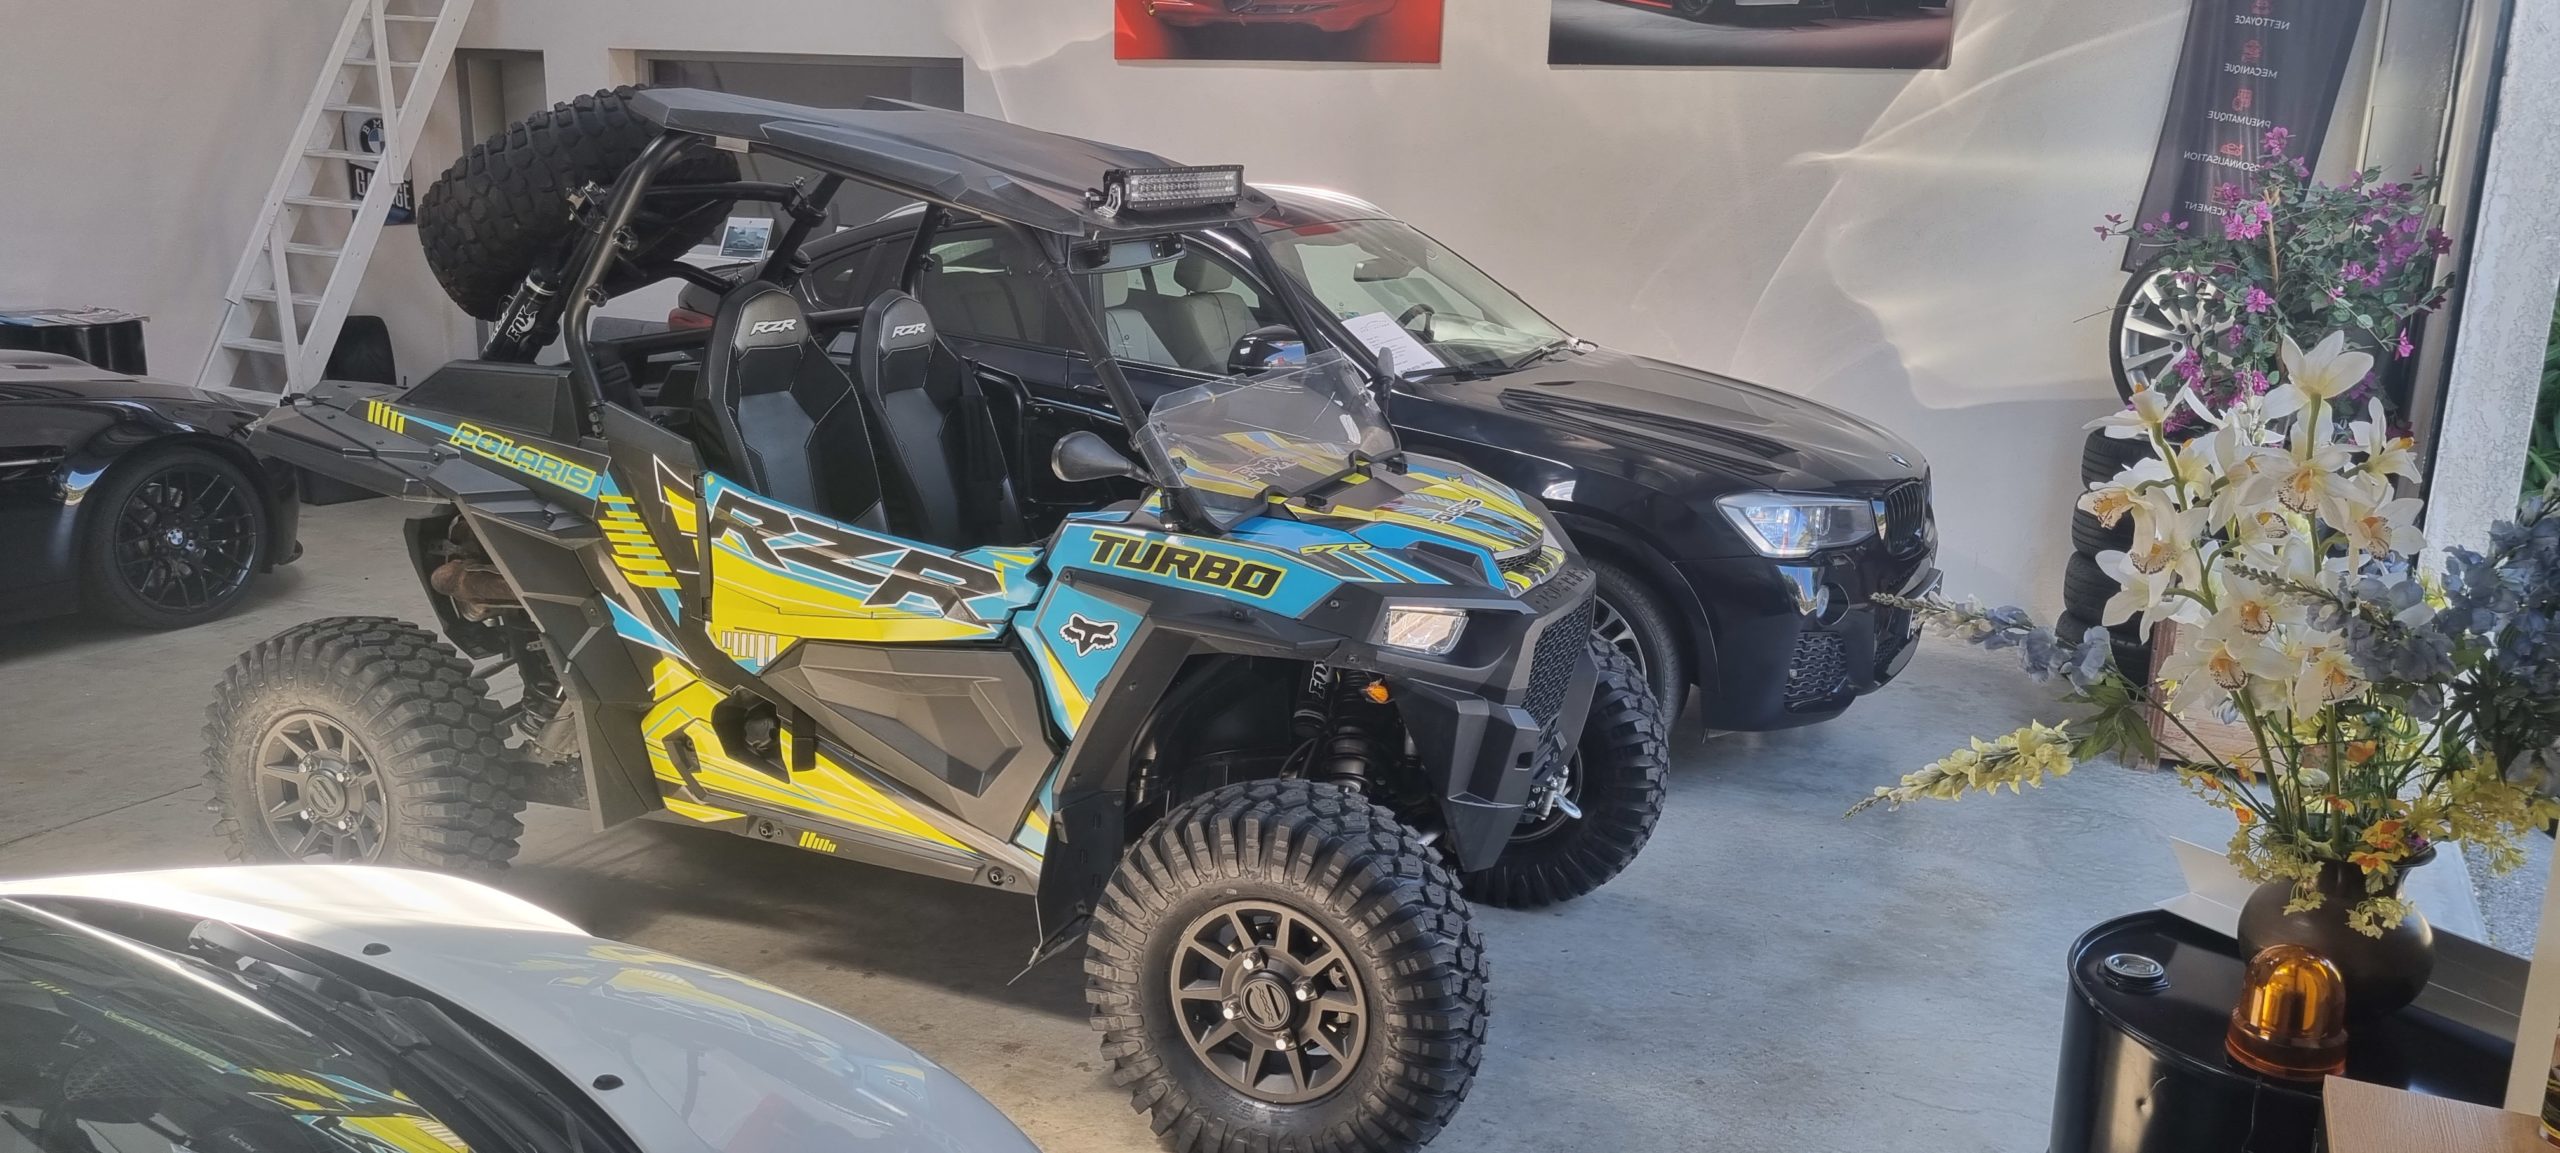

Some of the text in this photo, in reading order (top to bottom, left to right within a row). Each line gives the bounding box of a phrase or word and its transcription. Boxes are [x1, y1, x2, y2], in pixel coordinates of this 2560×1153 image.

[505, 304, 539, 342] FOX
[751, 318, 797, 336] RZR
[892, 323, 927, 339] RZR
[449, 422, 597, 494] POLARIS
[705, 486, 1006, 632] RZR
[1089, 529, 1288, 599] TURBO
[1308, 660, 1330, 699] FO
